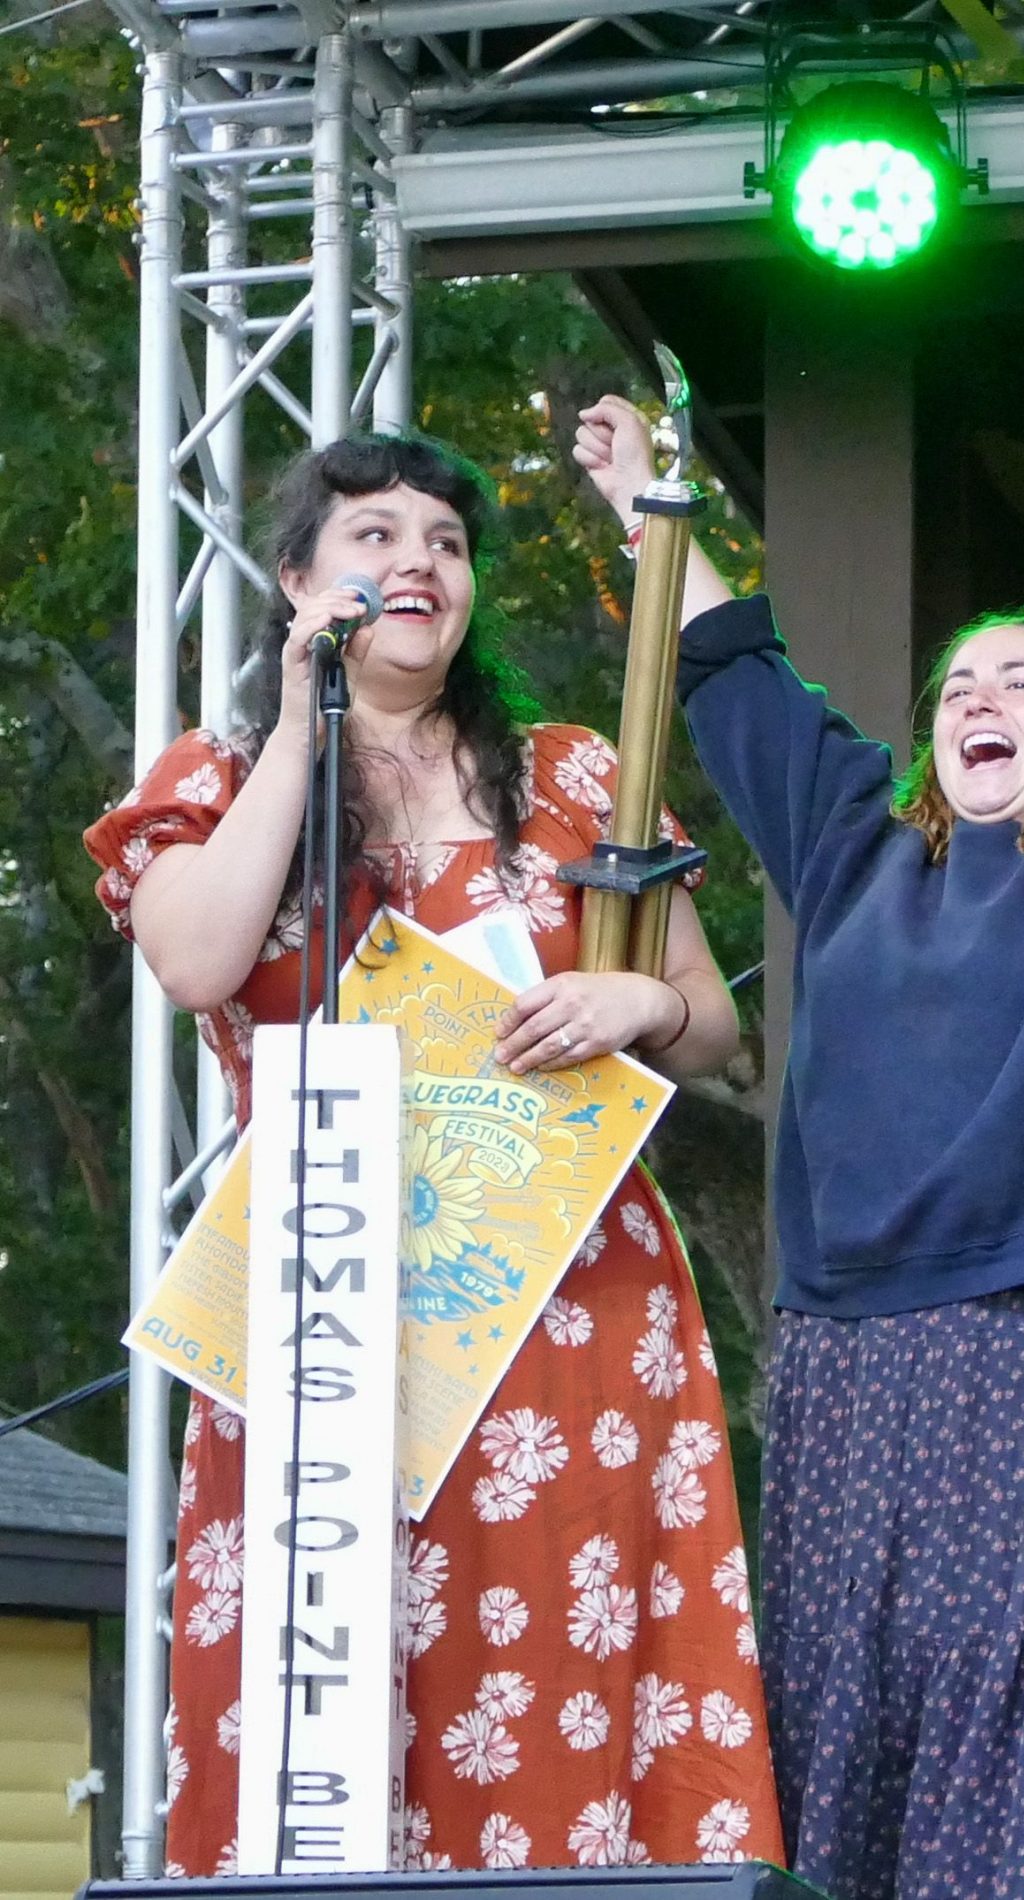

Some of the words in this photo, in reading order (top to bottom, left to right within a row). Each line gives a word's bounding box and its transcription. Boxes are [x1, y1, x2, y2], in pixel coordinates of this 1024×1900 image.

[423, 1005, 471, 1038] POINT
[413, 1082, 539, 1122] UEGRASS
[525, 1070, 573, 1104] BEACH
[445, 1119, 526, 1160] FESTIVAL
[198, 1222, 250, 1260] INFAMOU
[279, 1089, 367, 1402] THOMAS
[416, 1296, 447, 1311] INE
[460, 1271, 494, 1297] 1979
[142, 1316, 202, 1362] AUG
[206, 1353, 238, 1384] 31
[273, 1461, 359, 1716] POINT
